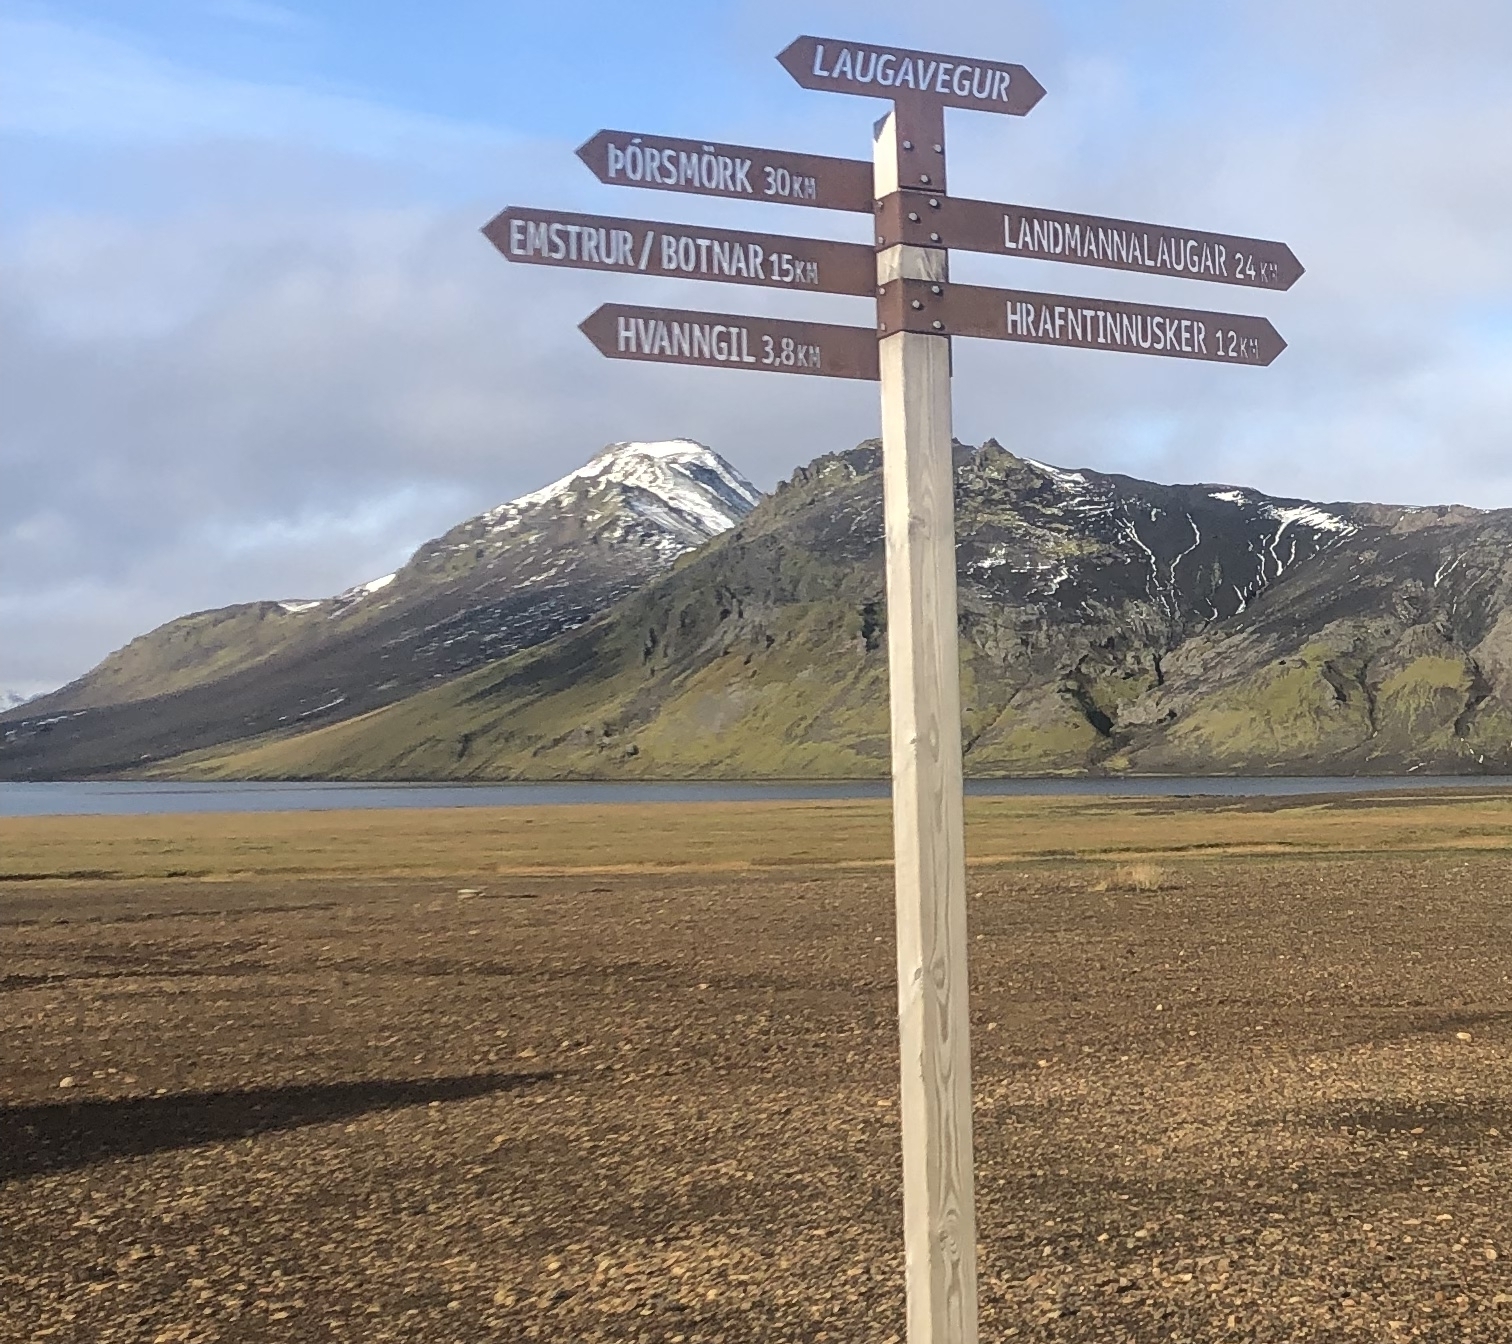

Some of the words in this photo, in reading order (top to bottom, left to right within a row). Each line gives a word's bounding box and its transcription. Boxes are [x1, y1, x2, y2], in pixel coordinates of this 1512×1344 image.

[812, 44, 1011, 102] LAUGAVEGUR
[607, 138, 753, 194] ÞÓRSMÖRK
[509, 218, 635, 267] EMSTRUR
[661, 235, 765, 280] BOTNAR
[1003, 214, 1228, 277] LANDMANNALAUGAR
[617, 315, 757, 364] HVANNGIL
[1006, 300, 1207, 356] HRAFNTINNUSKER
